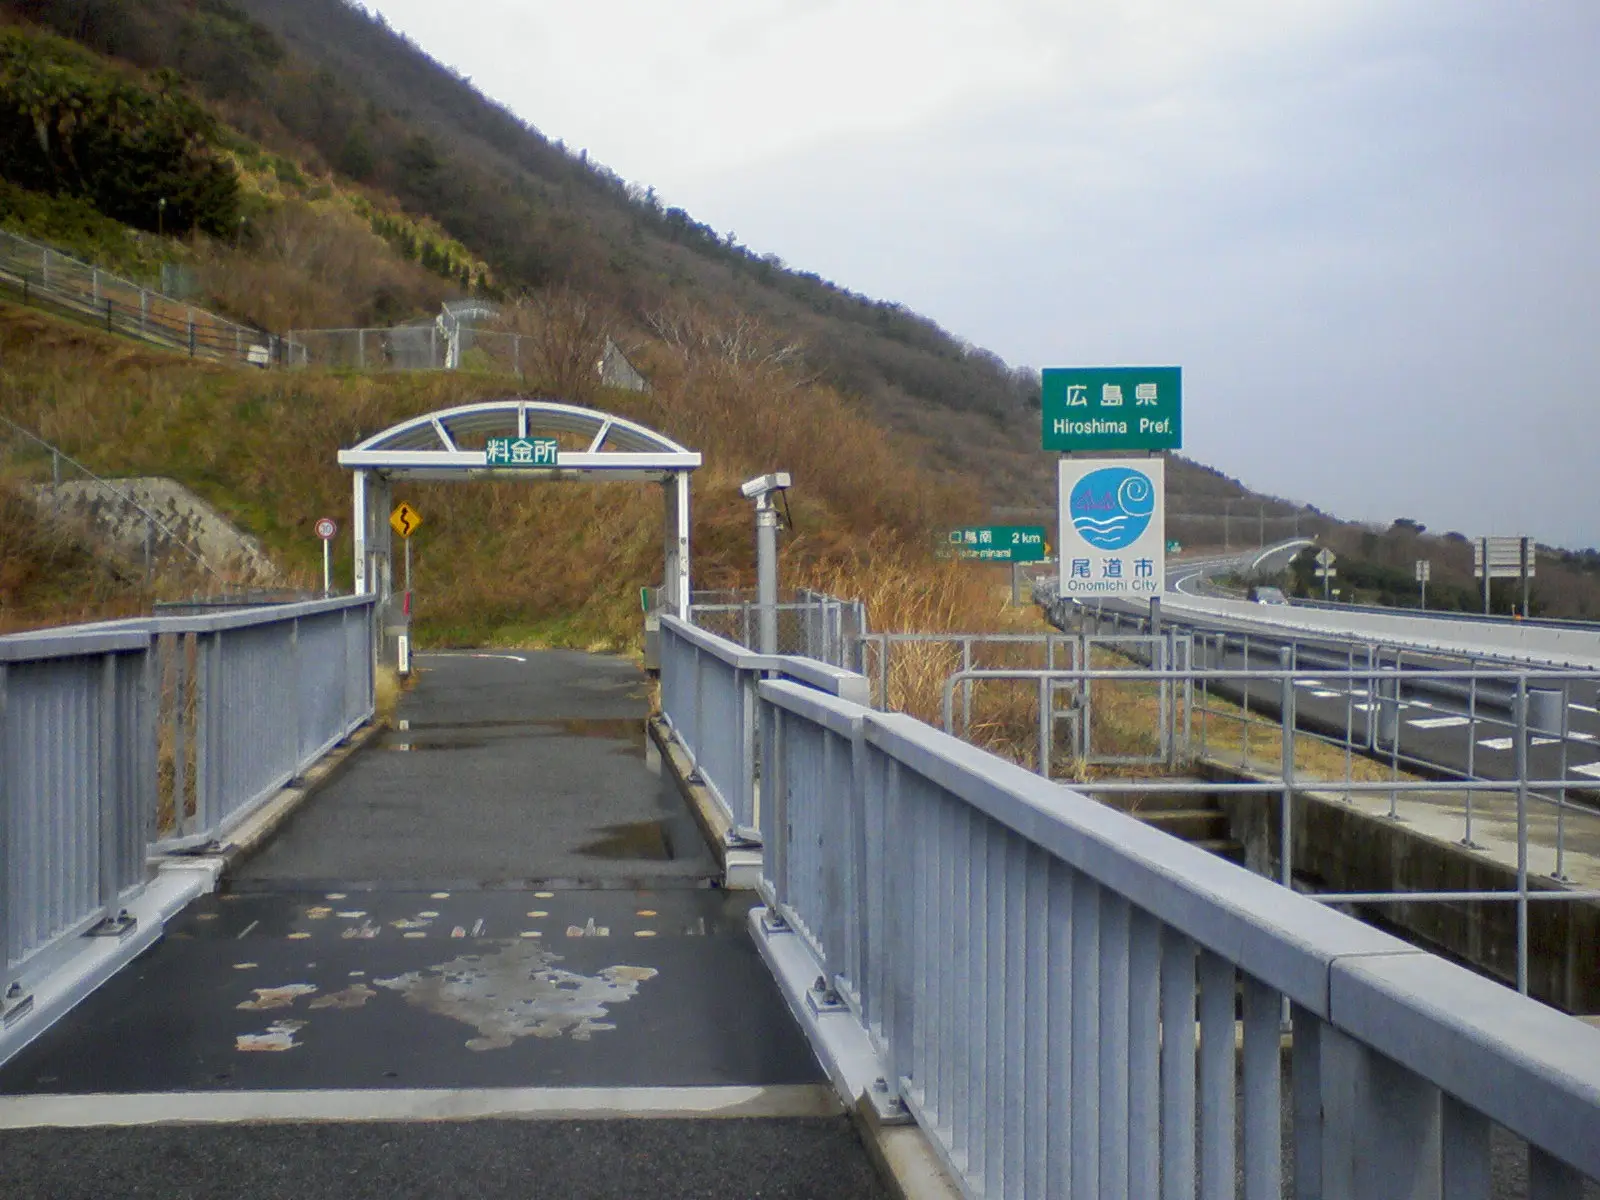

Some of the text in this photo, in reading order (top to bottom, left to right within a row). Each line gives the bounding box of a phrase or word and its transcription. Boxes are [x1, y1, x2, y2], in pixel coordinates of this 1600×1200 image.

[1066, 382, 1158, 407] 広島県
[1053, 416, 1174, 435] Hiroshima Pref.
[487, 438, 557, 463] 料金所
[1012, 532, 1041, 544] 2 km
[1070, 557, 1154, 578] 尾道市
[1068, 579, 1158, 593] Onomichi City
